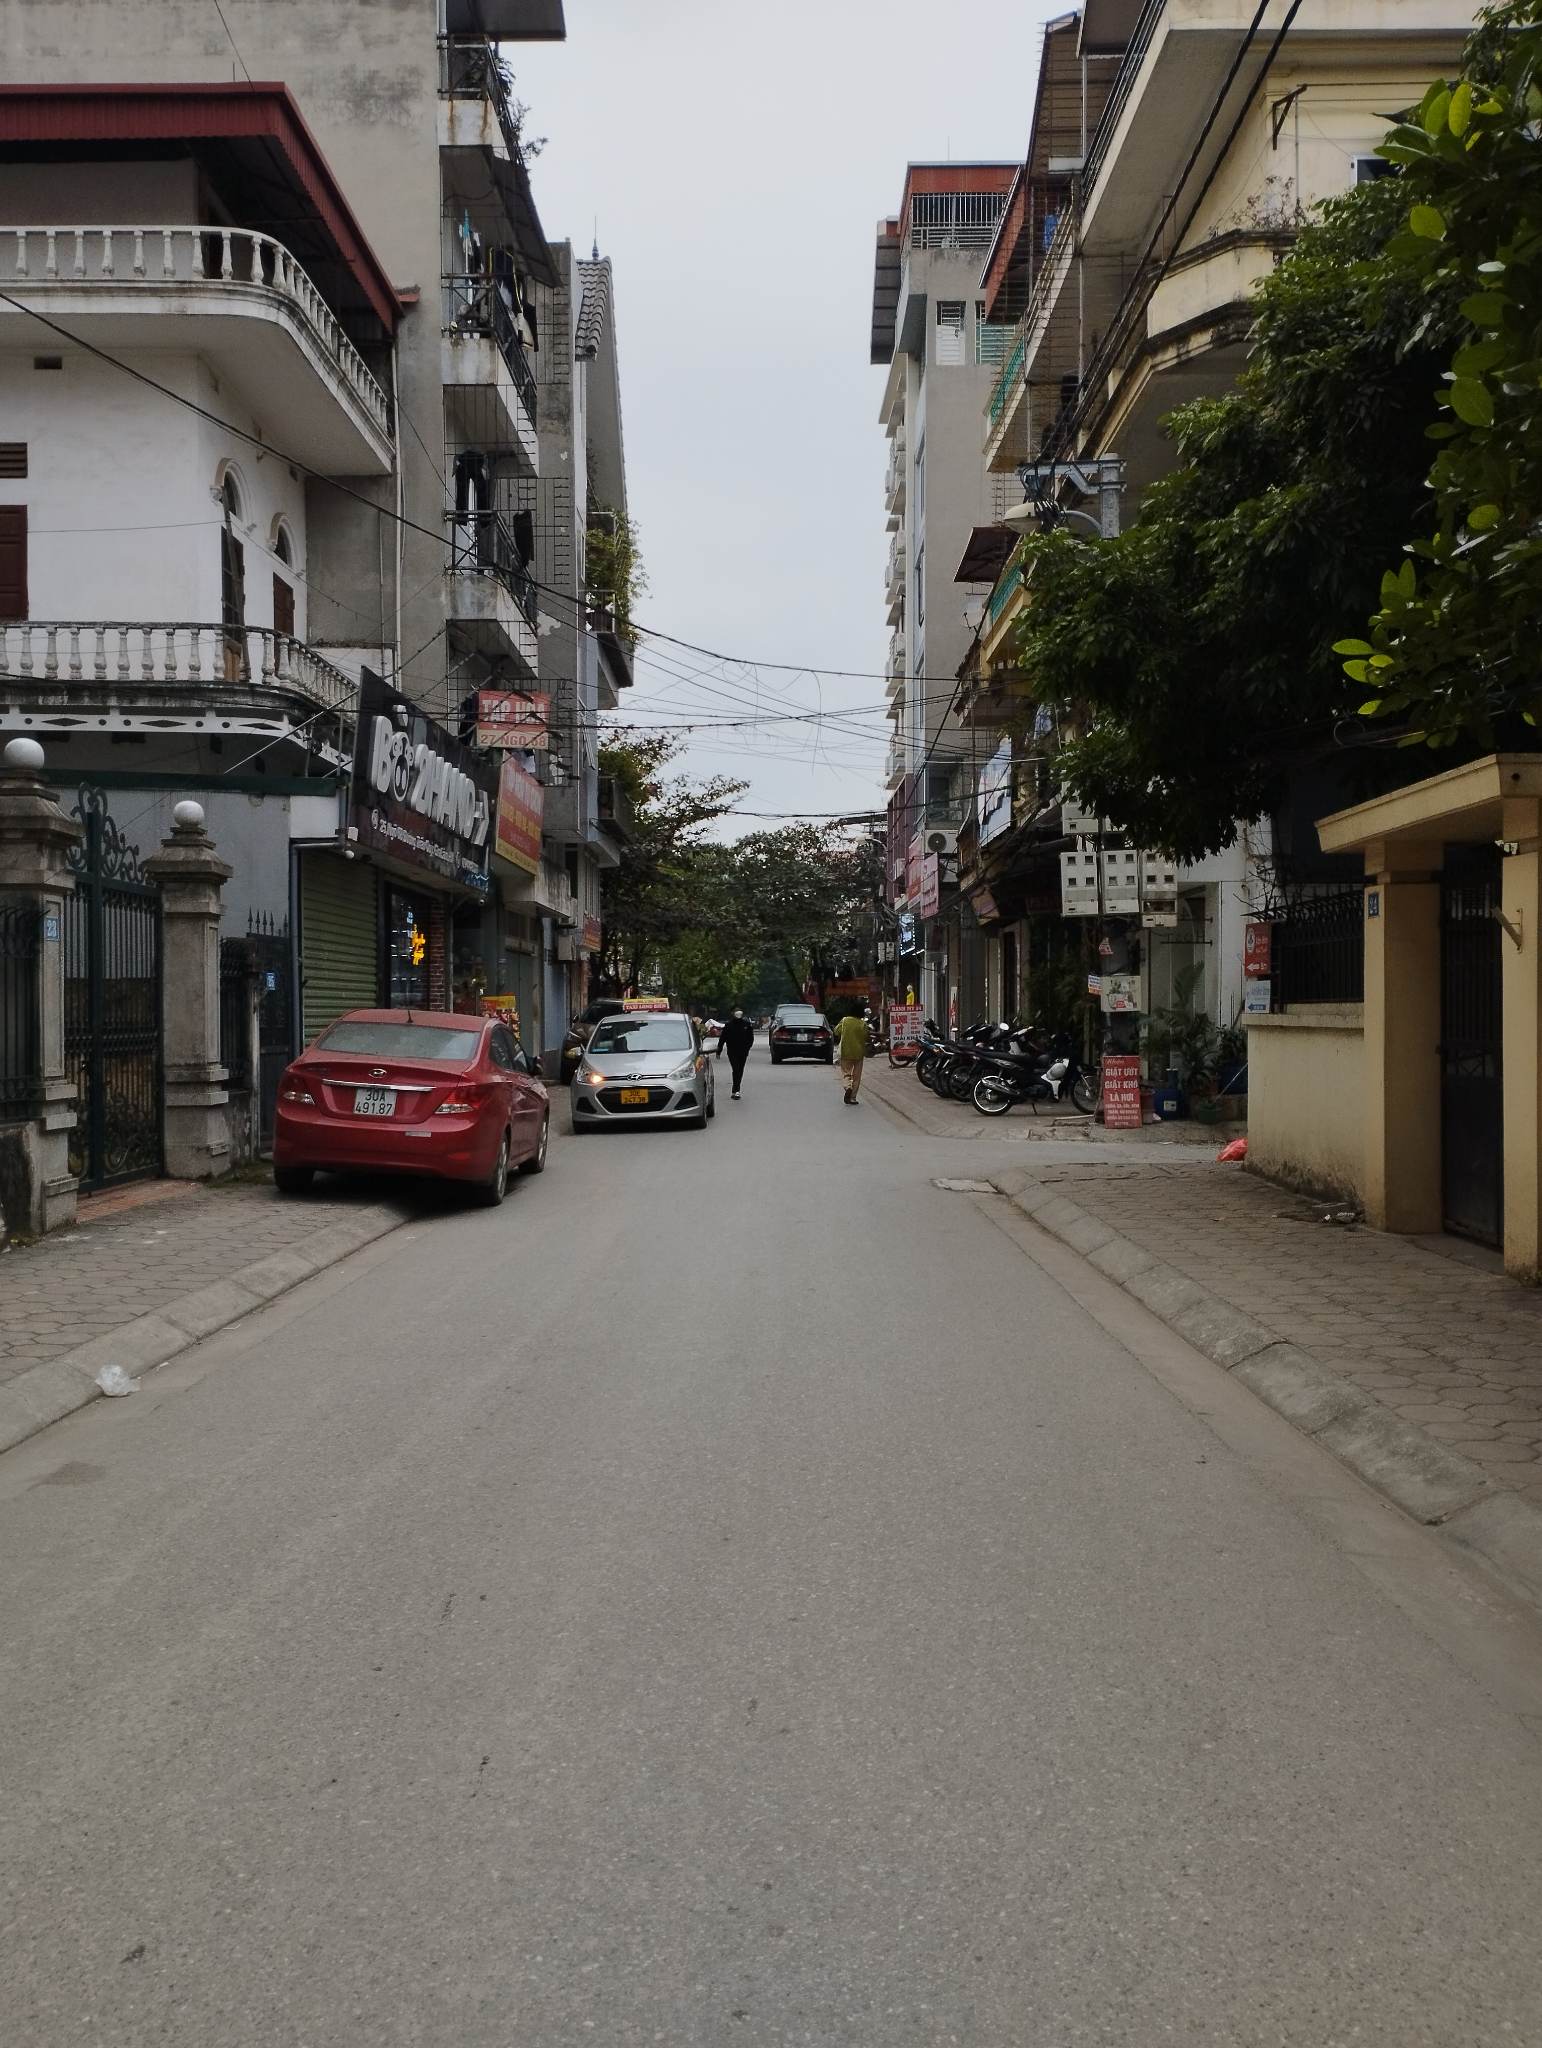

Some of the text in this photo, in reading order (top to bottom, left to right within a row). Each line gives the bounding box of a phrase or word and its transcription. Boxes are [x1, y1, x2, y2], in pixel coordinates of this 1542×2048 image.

[480, 734, 496, 745] 27
[47, 919, 57, 938] 23
[366, 1089, 386, 1102] 30A
[355, 1102, 393, 1115] 491.87
